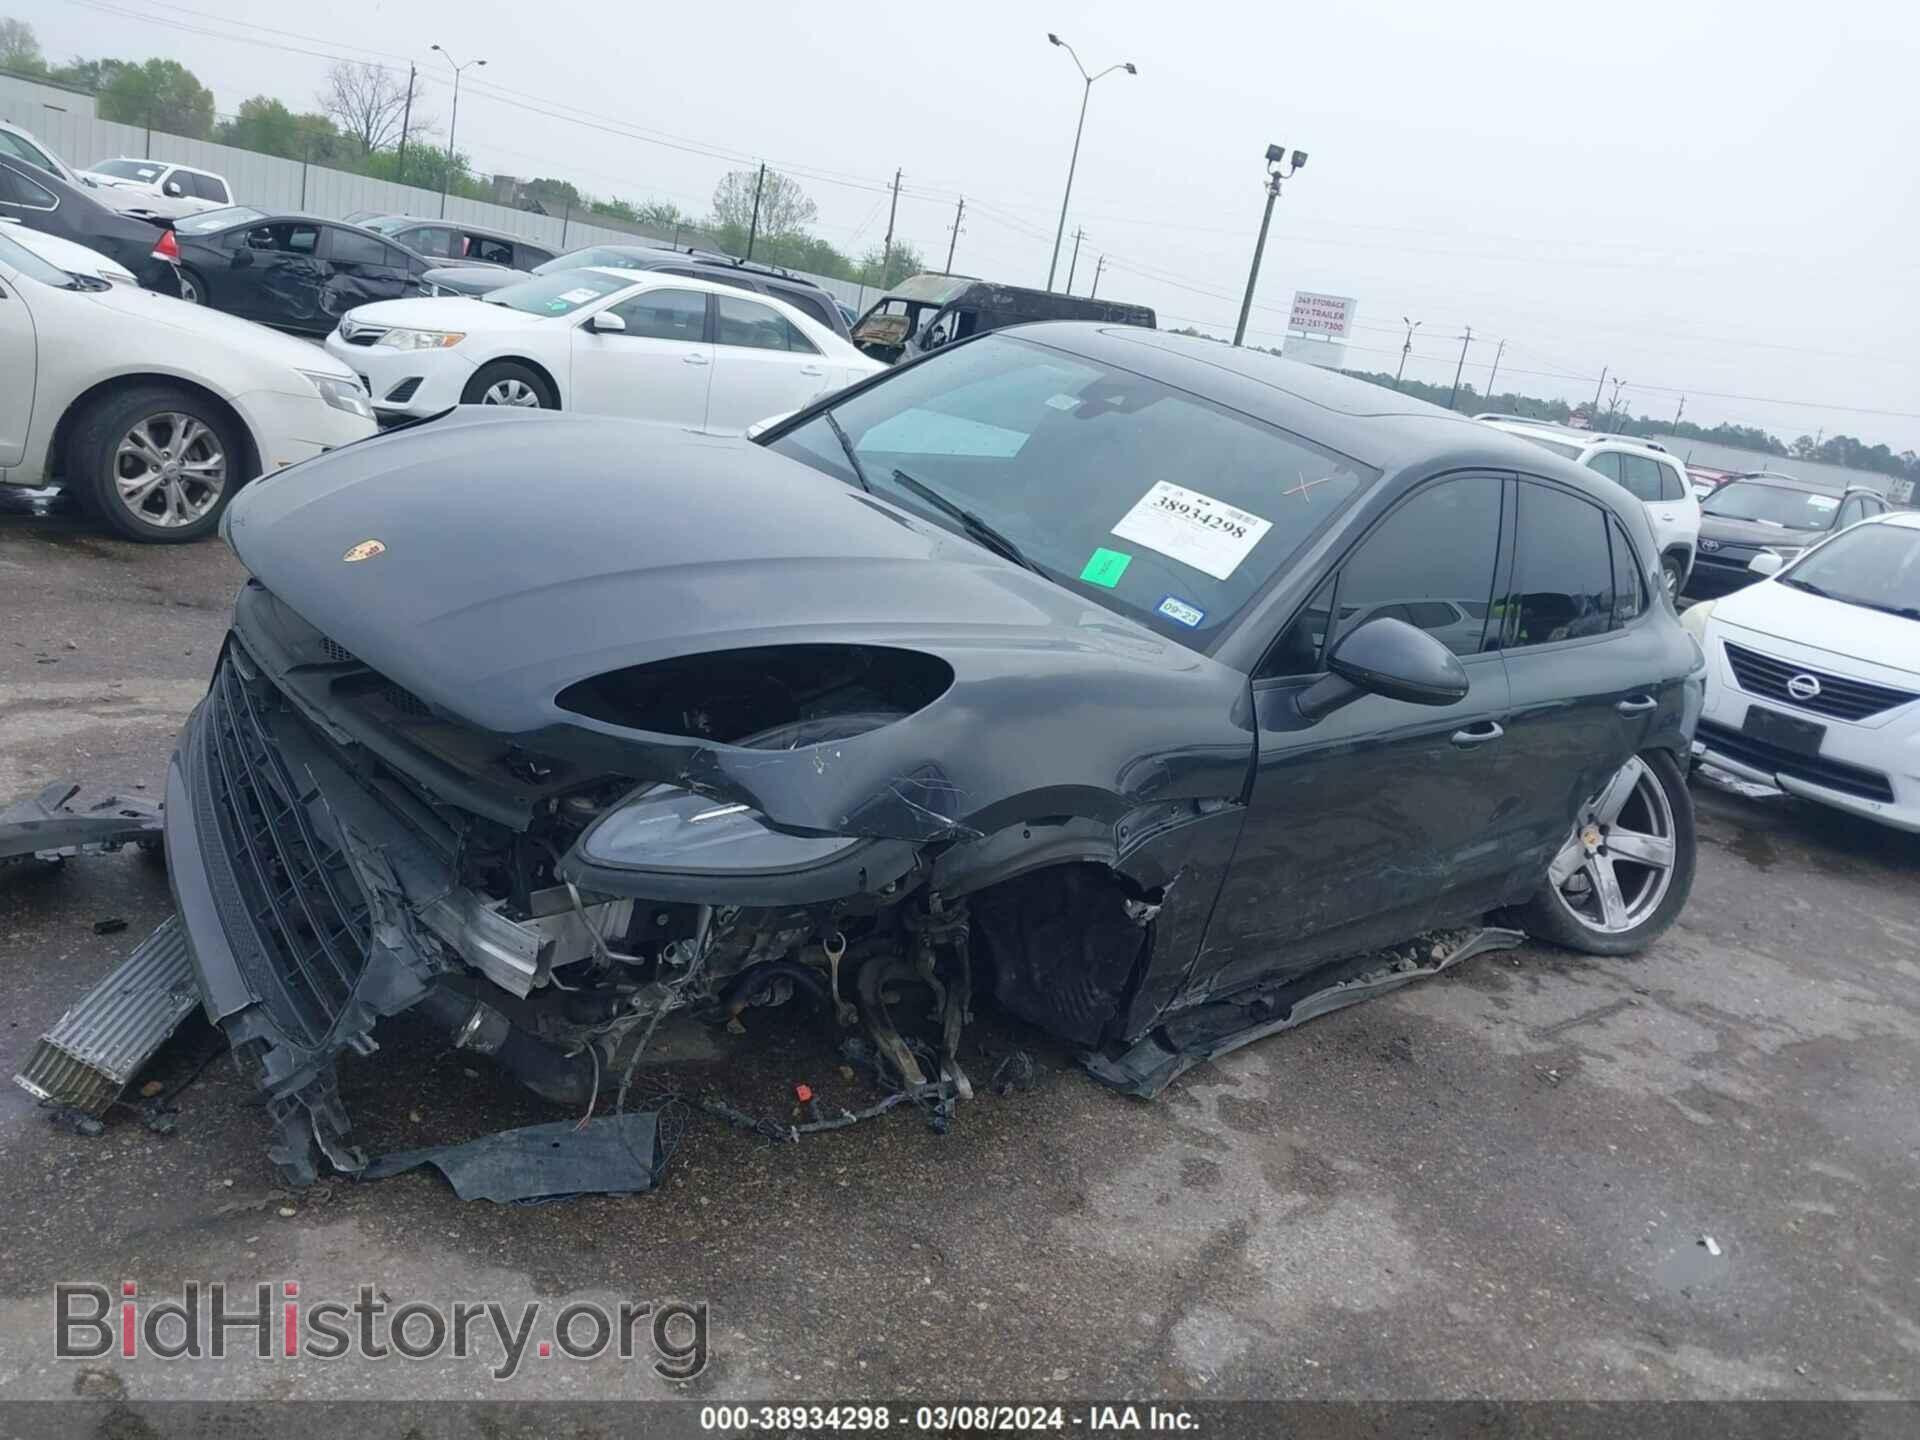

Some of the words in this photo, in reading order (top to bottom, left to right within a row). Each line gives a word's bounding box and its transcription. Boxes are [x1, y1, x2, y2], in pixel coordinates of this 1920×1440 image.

[1312, 298, 1345, 309] STORAGE
[1311, 308, 1345, 320] TRAILER
[1153, 496, 1247, 538] 38934298
